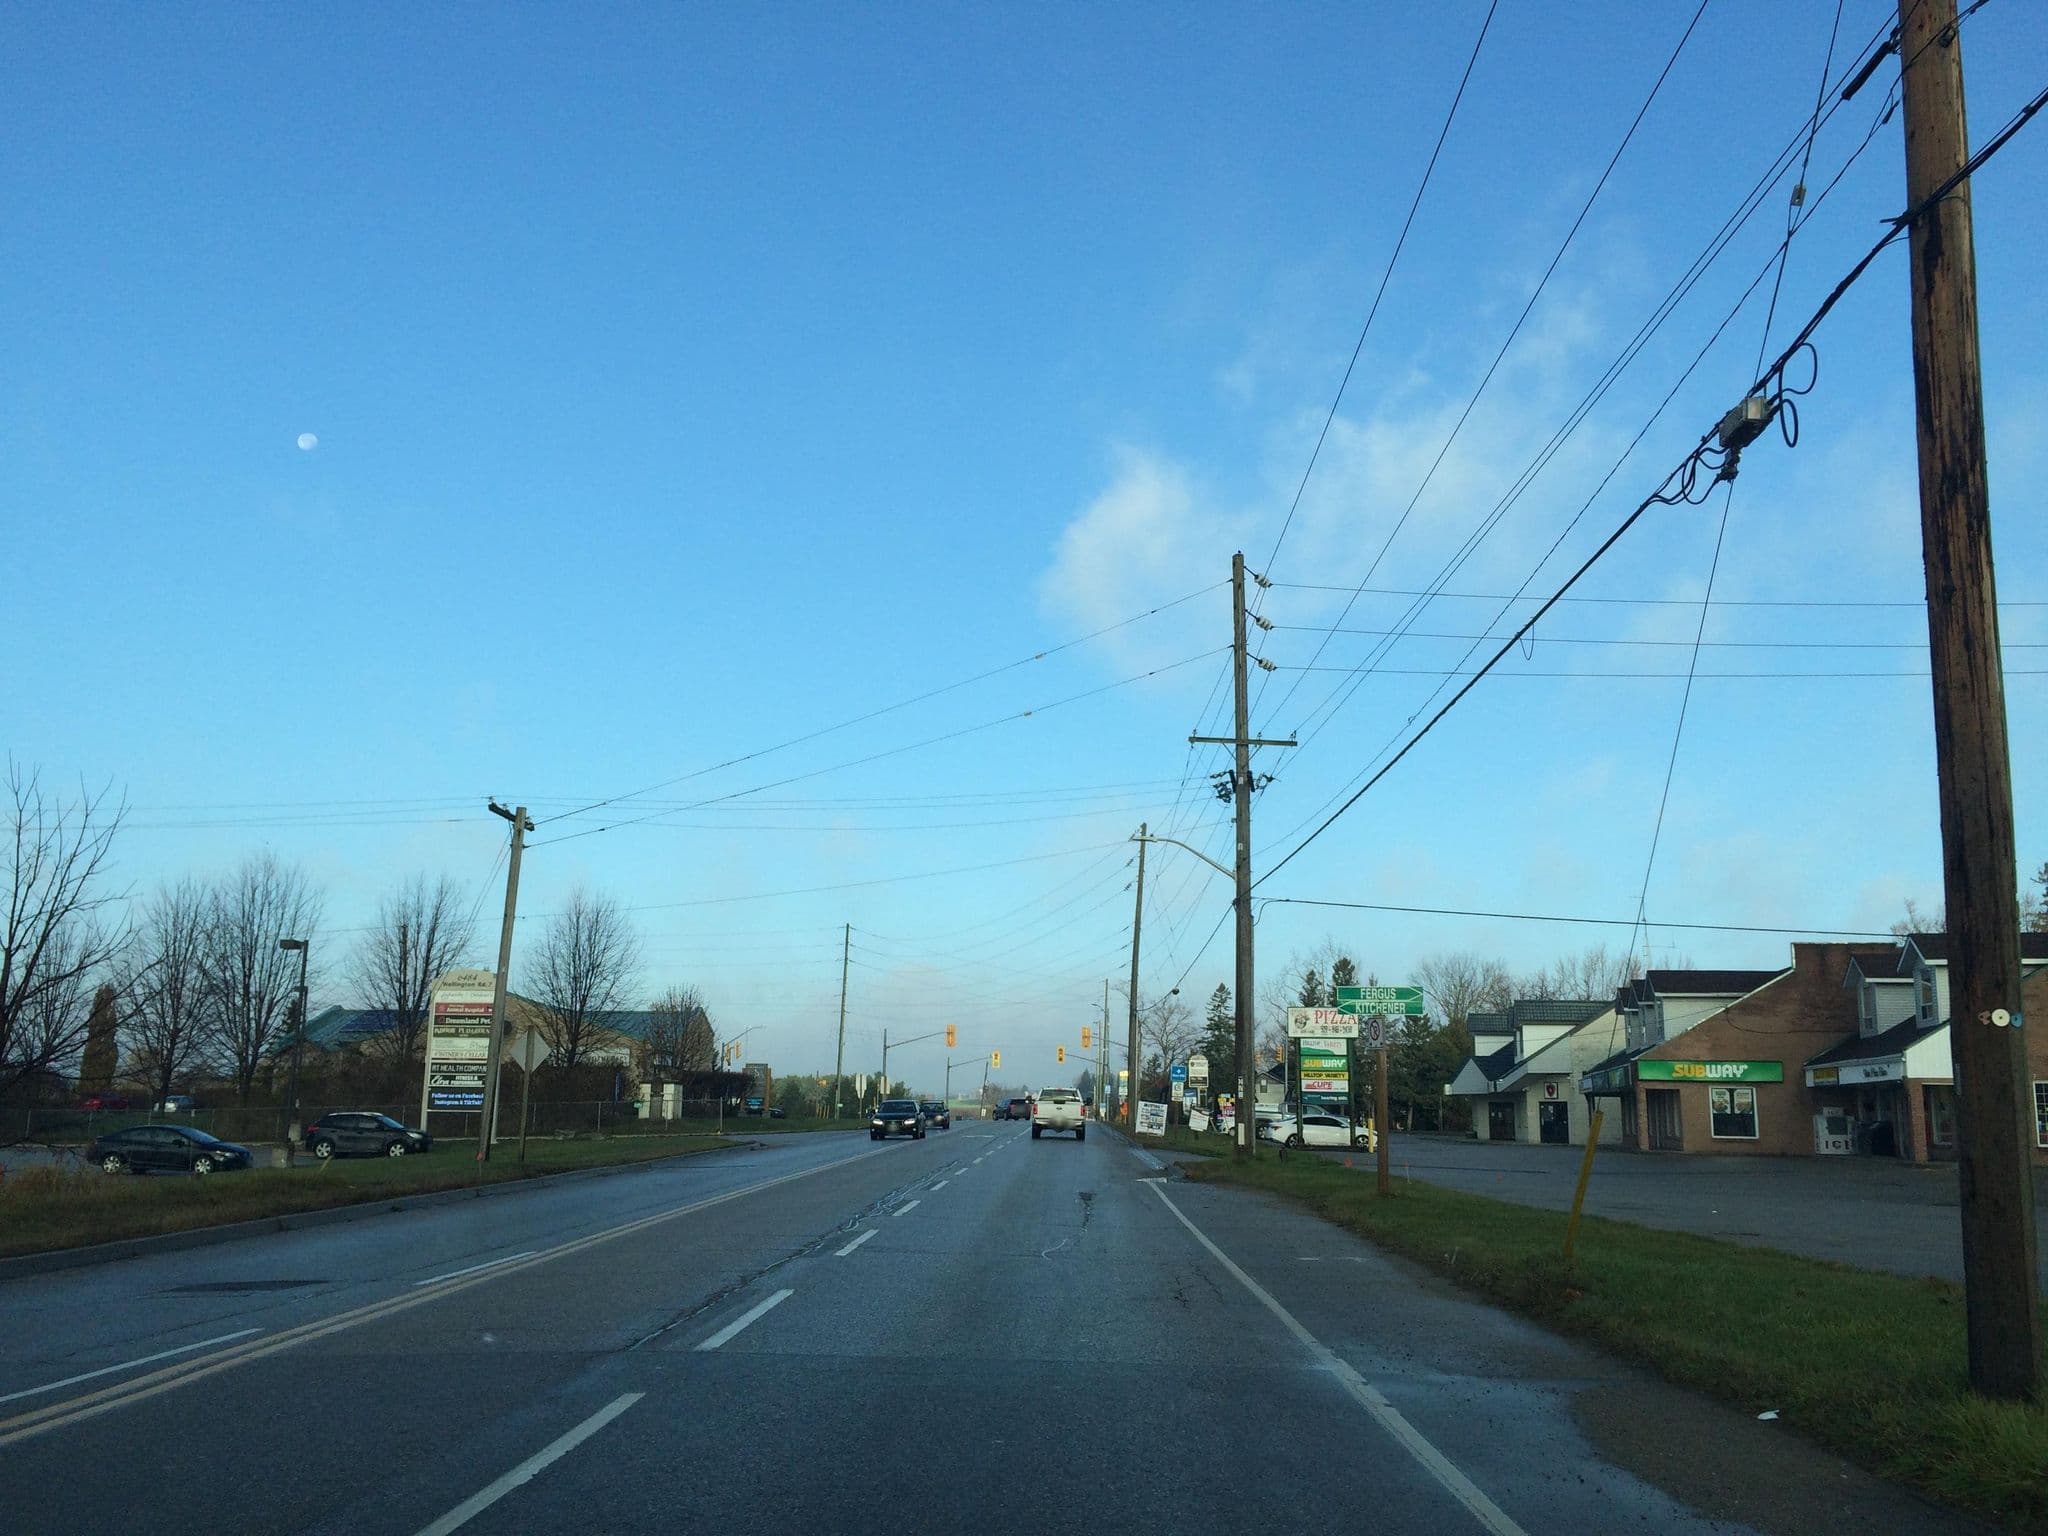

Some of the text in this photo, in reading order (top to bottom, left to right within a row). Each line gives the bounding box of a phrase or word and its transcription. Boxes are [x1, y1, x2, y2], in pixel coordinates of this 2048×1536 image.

[1360, 988, 1397, 1000] FERGUS
[1355, 1002, 1406, 1014] KITCHENER
[1314, 1009, 1358, 1024] PIZZA
[1303, 1058, 1346, 1068] SUBWAY
[1671, 1064, 1747, 1079] SUBWAY
